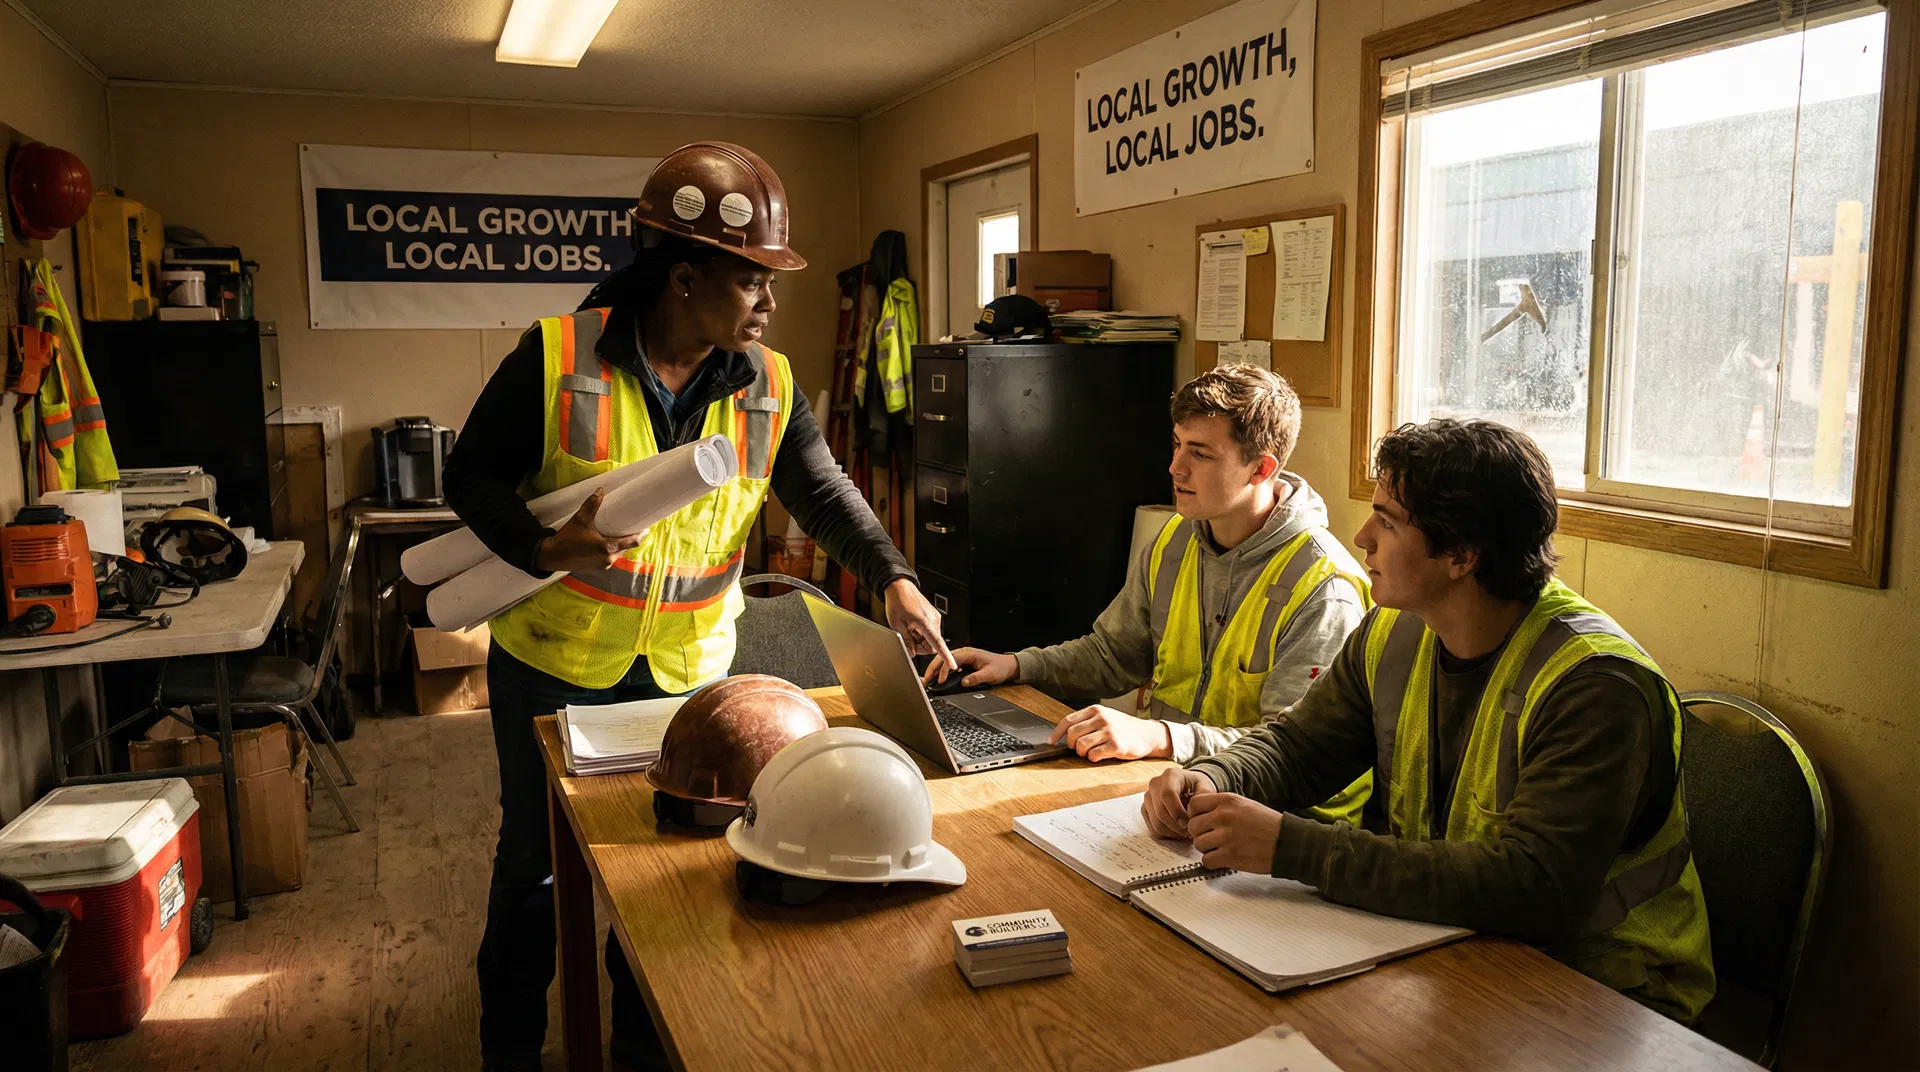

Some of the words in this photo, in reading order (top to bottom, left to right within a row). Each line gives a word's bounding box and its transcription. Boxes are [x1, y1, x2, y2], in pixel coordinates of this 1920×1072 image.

[1087, 78, 1158, 133] LOCAL
[1164, 27, 1297, 108] GROWTH,
[1106, 122, 1179, 175] LOCAL
[1184, 98, 1264, 155] JOBS.
[346, 203, 469, 233] LOCAL
[385, 241, 505, 271] LOCAL
[514, 243, 611, 272] JOBS.
[986, 917, 1046, 928] COMMUNITY
